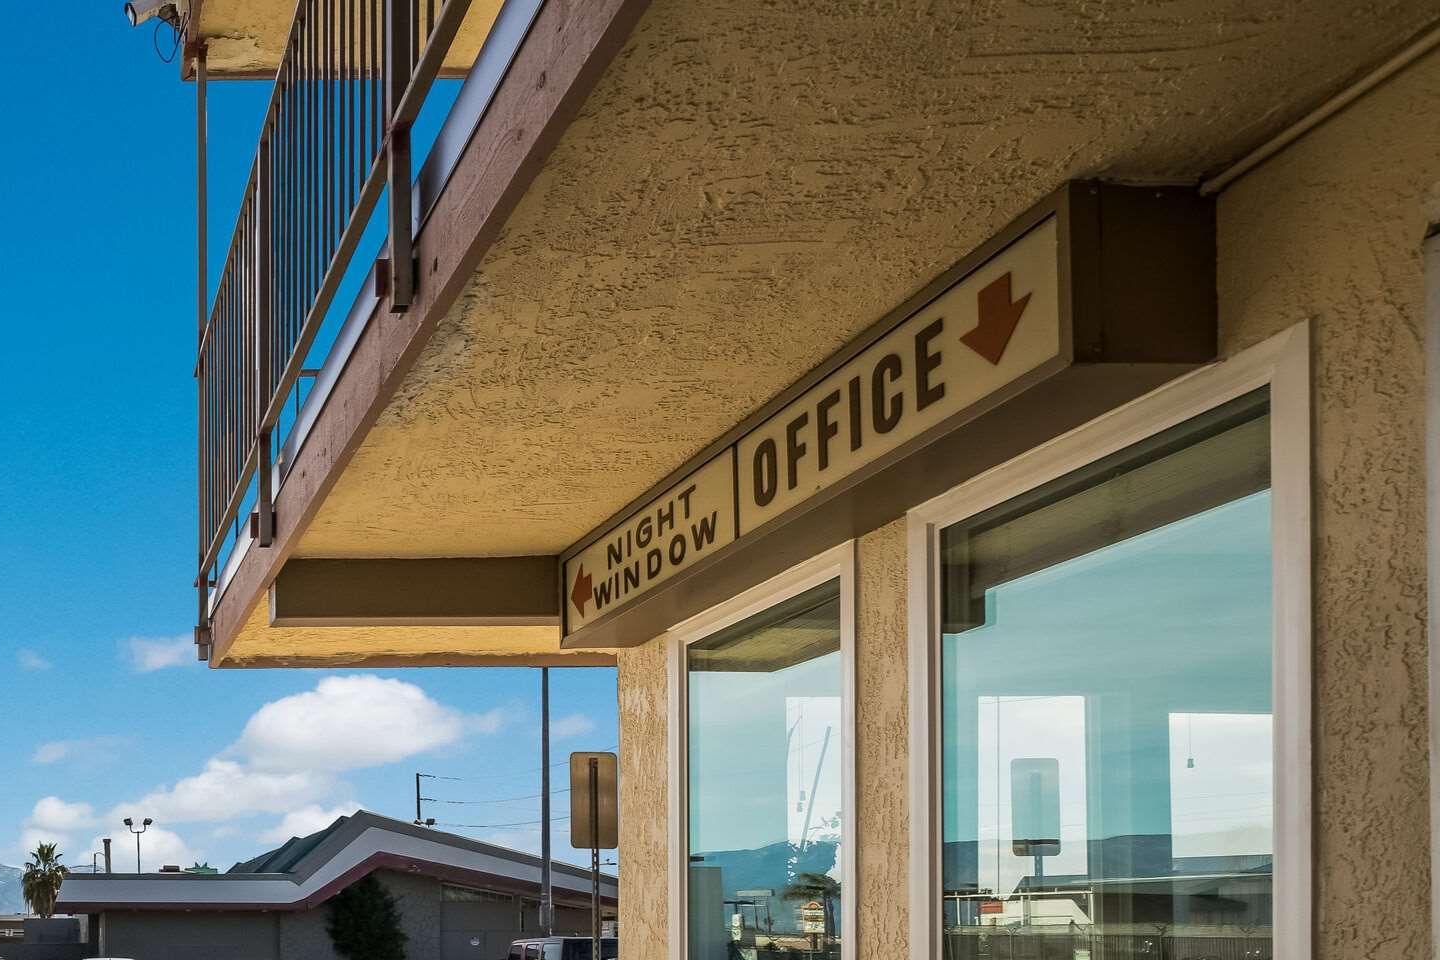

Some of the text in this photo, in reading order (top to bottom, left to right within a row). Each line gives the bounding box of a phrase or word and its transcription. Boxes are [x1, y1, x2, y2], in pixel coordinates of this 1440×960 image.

[752, 317, 946, 508] OFFICE
[593, 511, 718, 610] WINDOW
[606, 485, 697, 570] NIGHT
